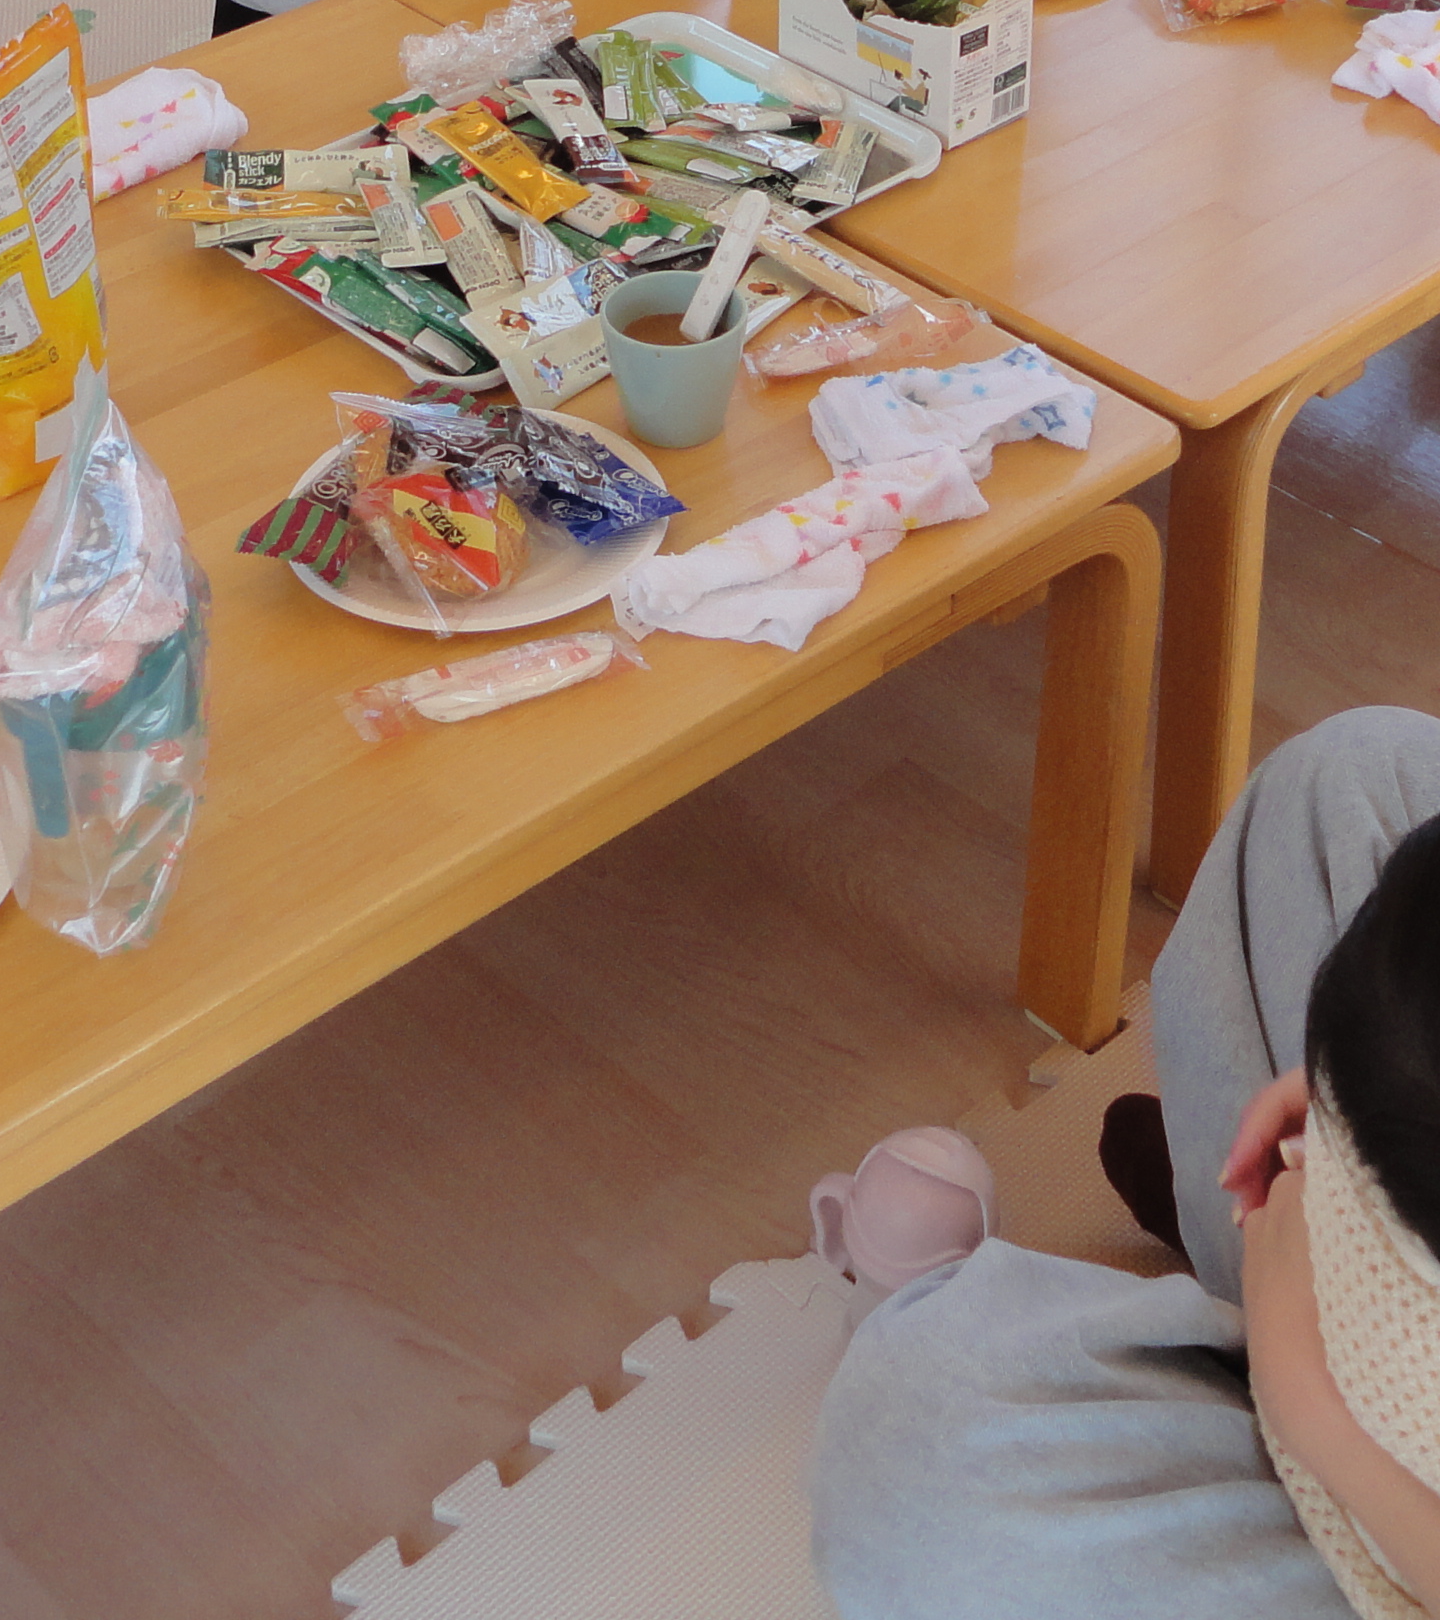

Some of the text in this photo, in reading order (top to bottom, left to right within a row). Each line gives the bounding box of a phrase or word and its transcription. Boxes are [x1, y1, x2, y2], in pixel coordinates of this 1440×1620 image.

[238, 151, 282, 168] Blendy
[238, 164, 265, 177] stick
[238, 175, 283, 186] カフェオレ
